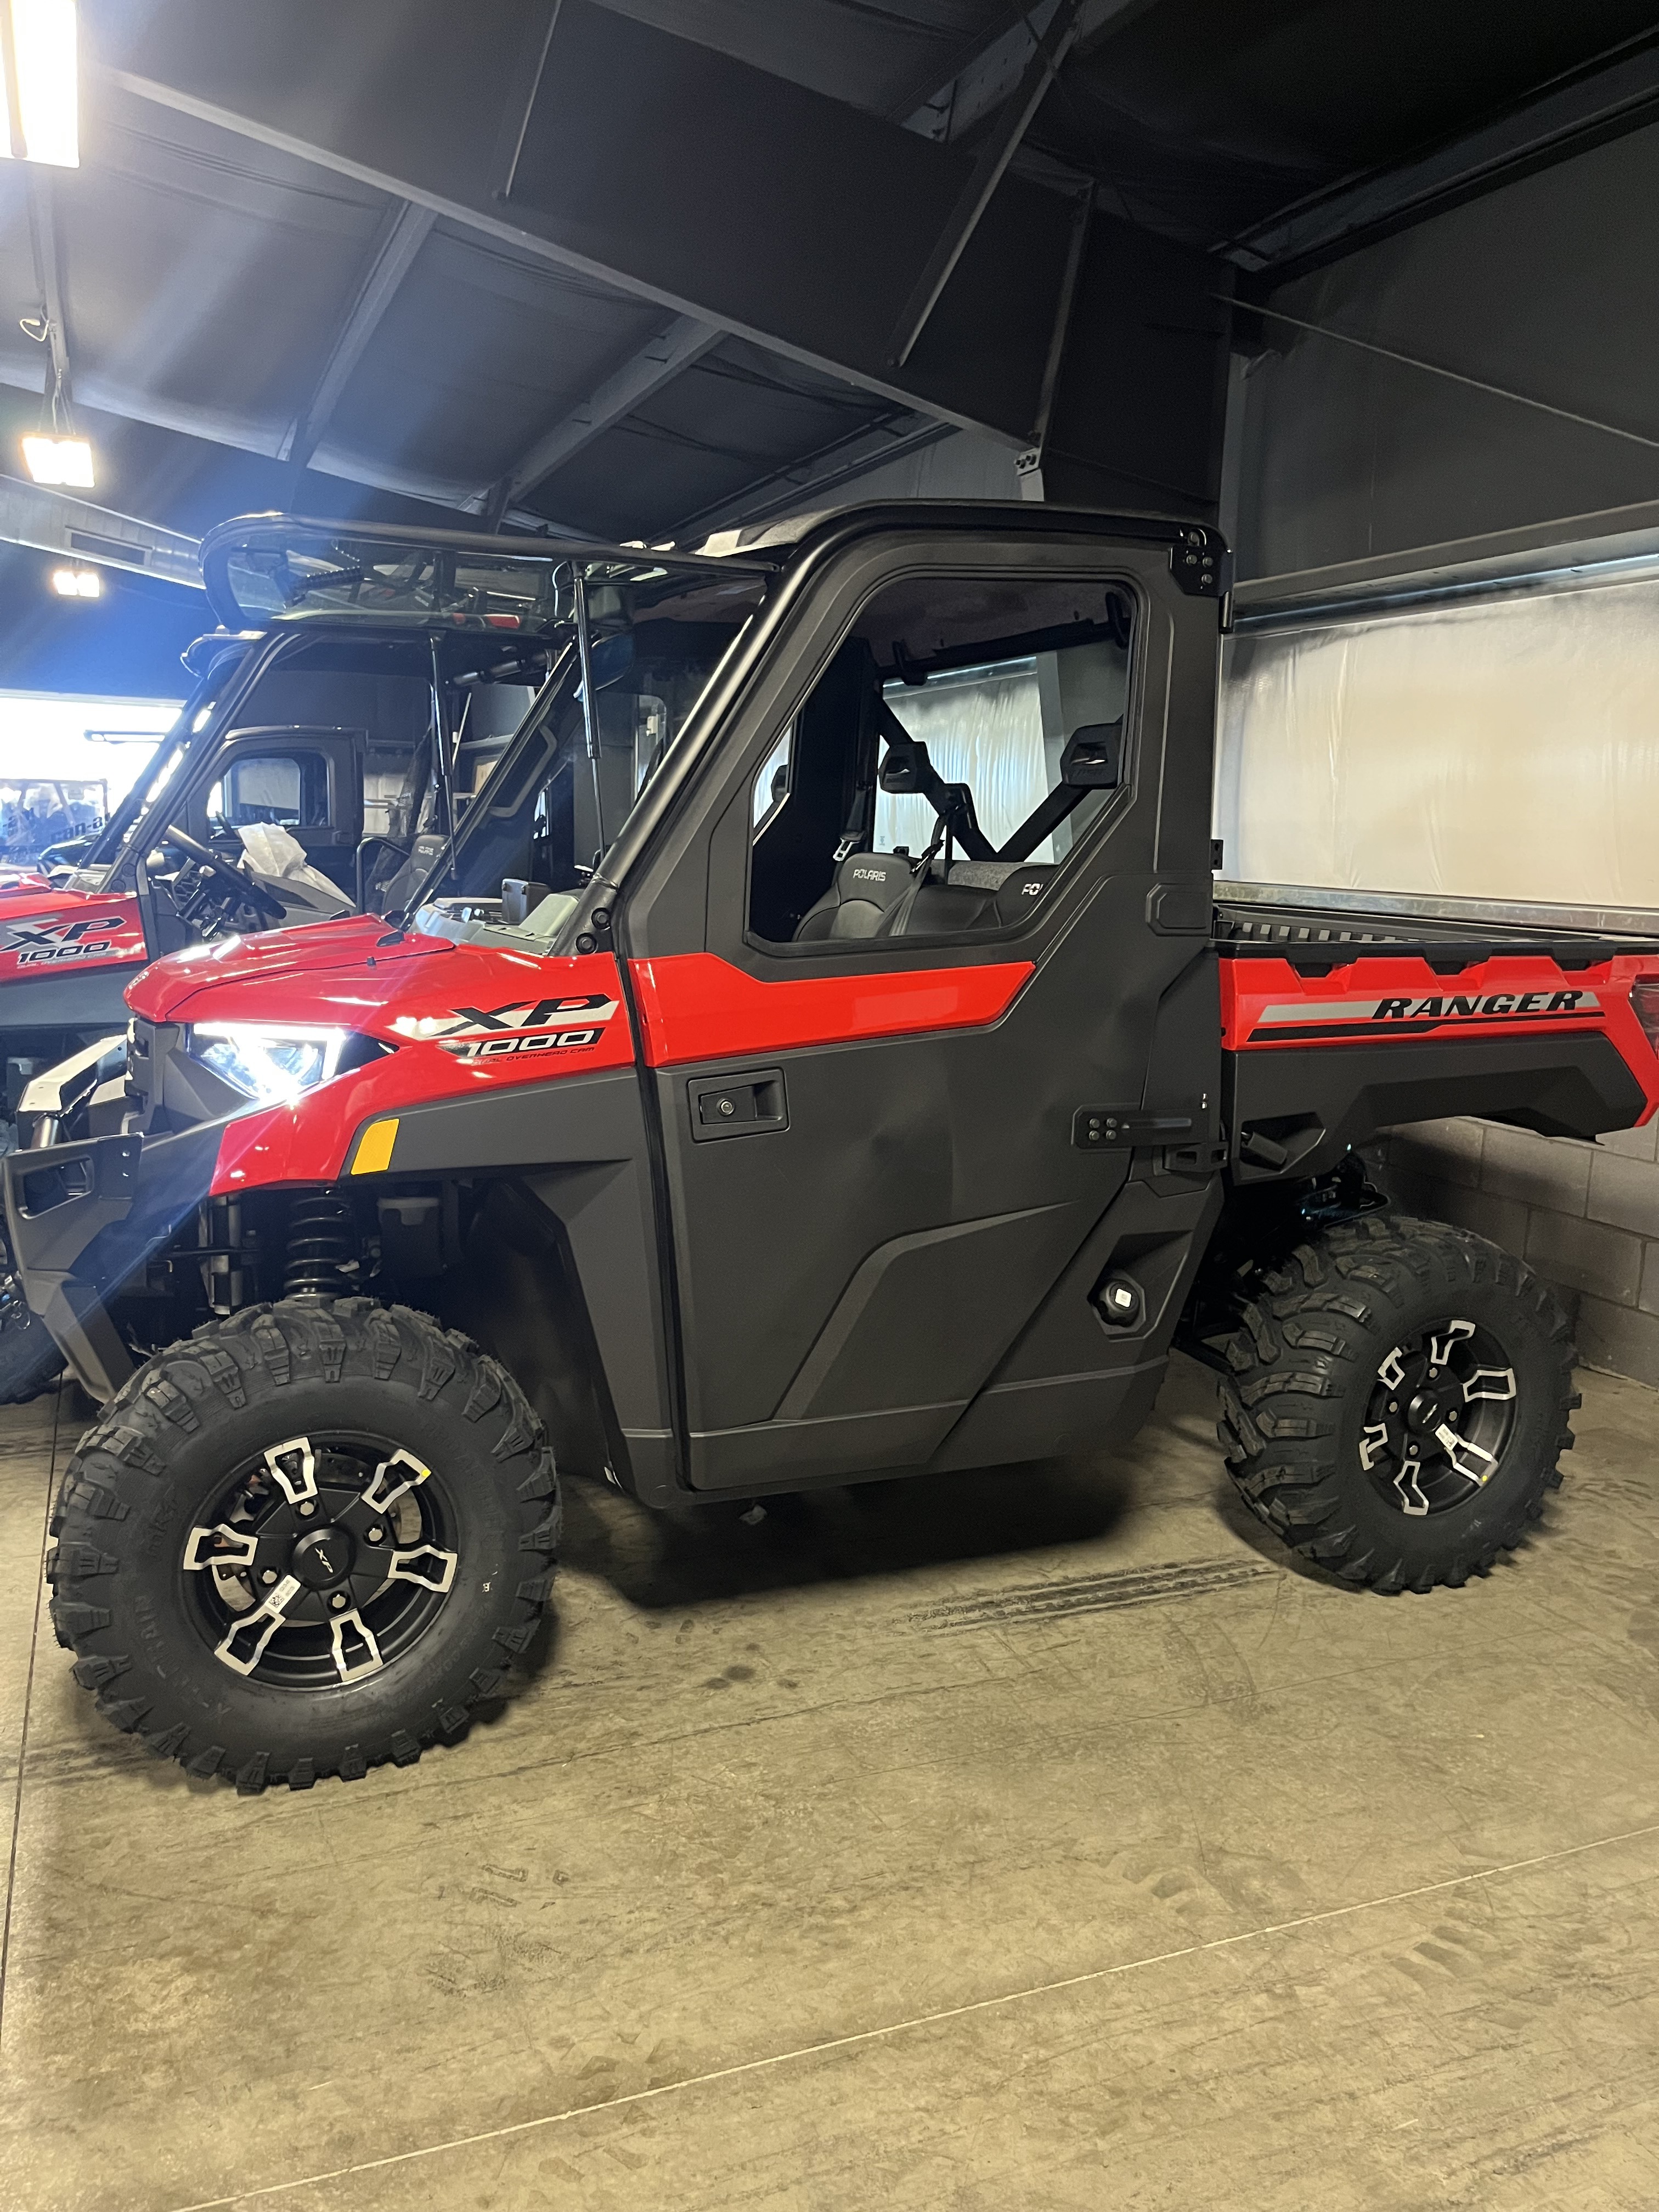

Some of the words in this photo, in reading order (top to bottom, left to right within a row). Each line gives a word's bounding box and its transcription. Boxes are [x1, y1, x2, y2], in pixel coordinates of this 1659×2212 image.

[853, 869, 887, 882] POLARIS
[0, 916, 126, 952] XP
[18, 940, 111, 964] 1000
[427, 994, 613, 1037] XP
[1372, 990, 1583, 1020] RANGER
[466, 1030, 595, 1057] 1000
[506, 1049, 568, 1061] OVERHEAD
